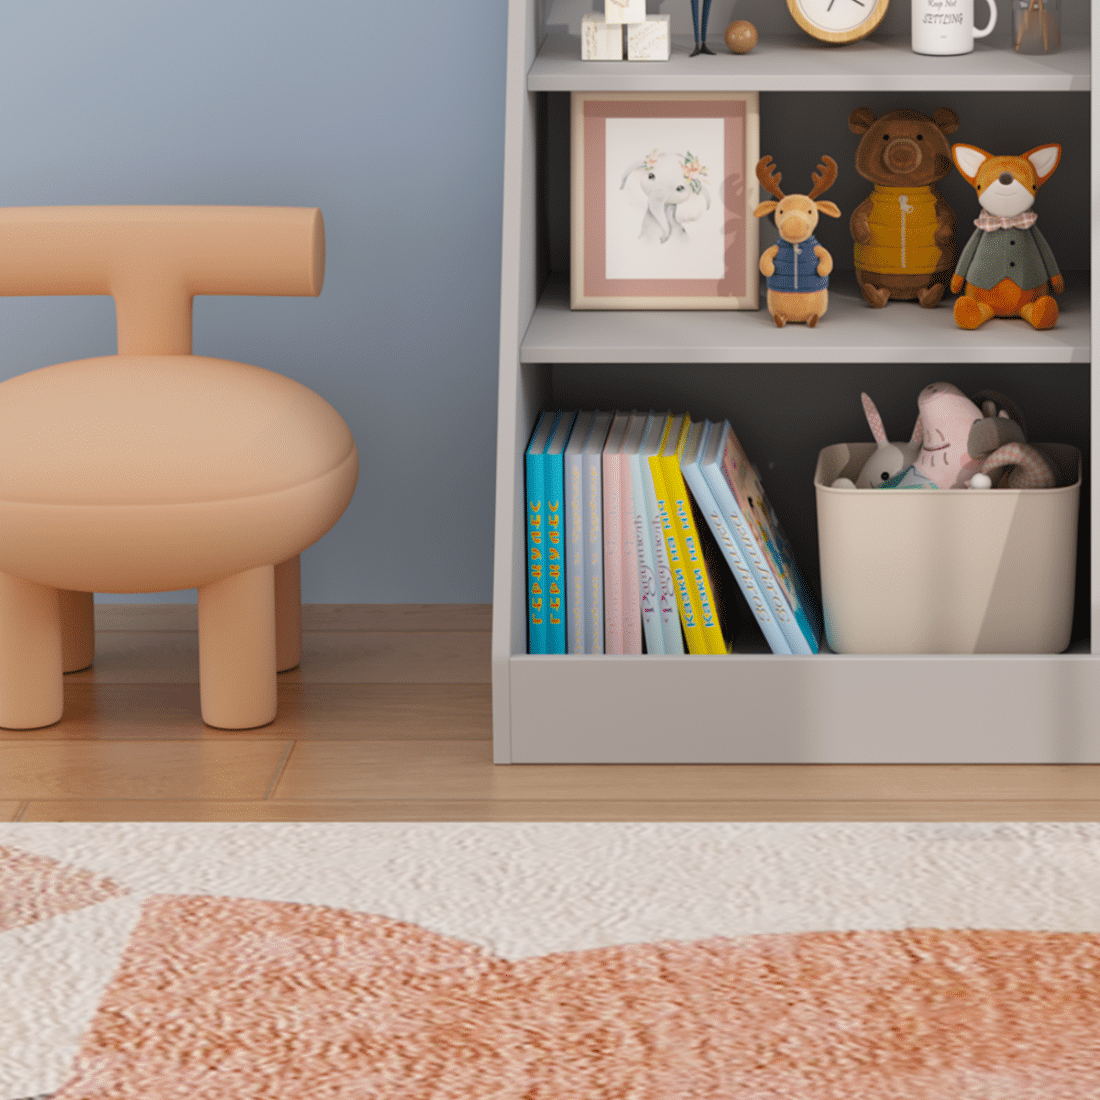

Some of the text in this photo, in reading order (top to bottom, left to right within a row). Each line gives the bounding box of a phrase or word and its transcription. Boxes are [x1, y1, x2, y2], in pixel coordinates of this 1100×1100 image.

[529, 500, 542, 624] ГЕРКУЛЕС
[547, 500, 561, 624] ГЕРКУЛЕС
[658, 499, 696, 628] Казки на ніч
[676, 499, 715, 628] Казки на ніч
[711, 511, 771, 623] Золушка
[730, 511, 790, 623] Золушка
